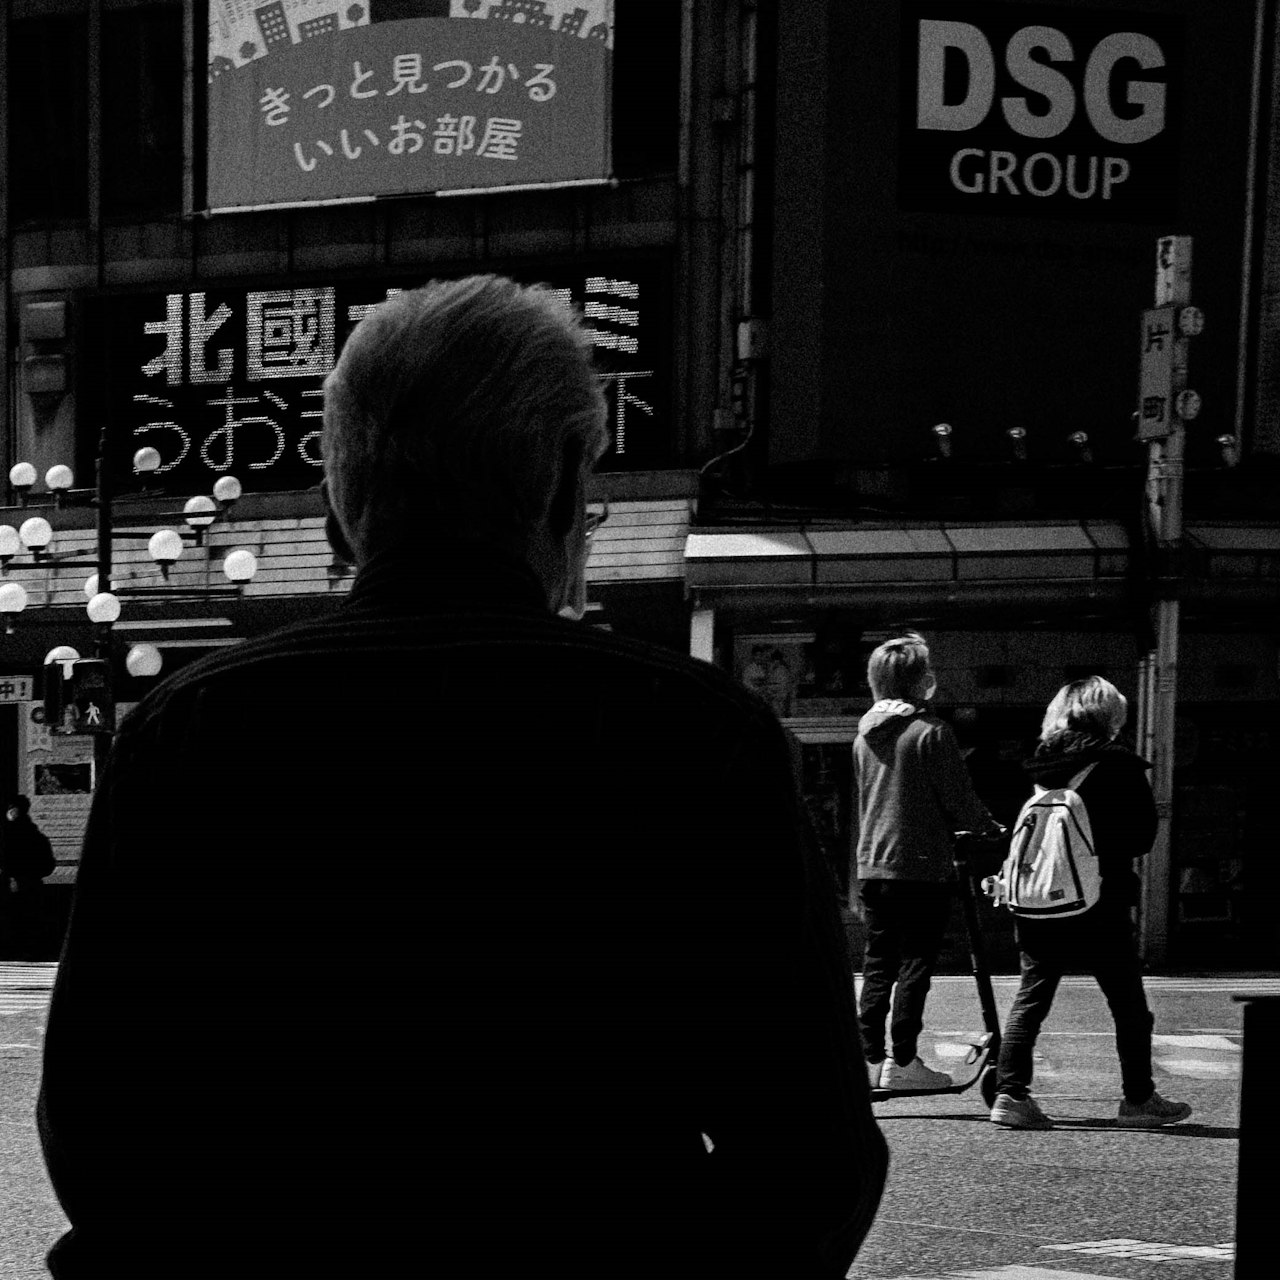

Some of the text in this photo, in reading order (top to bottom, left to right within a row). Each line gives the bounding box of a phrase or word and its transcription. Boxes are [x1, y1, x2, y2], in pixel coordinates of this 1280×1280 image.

[258, 52, 558, 126] きっと見つかる
[915, 18, 1168, 145] DSG
[293, 113, 523, 172] いいお部屋
[948, 147, 1131, 201] GROUP
